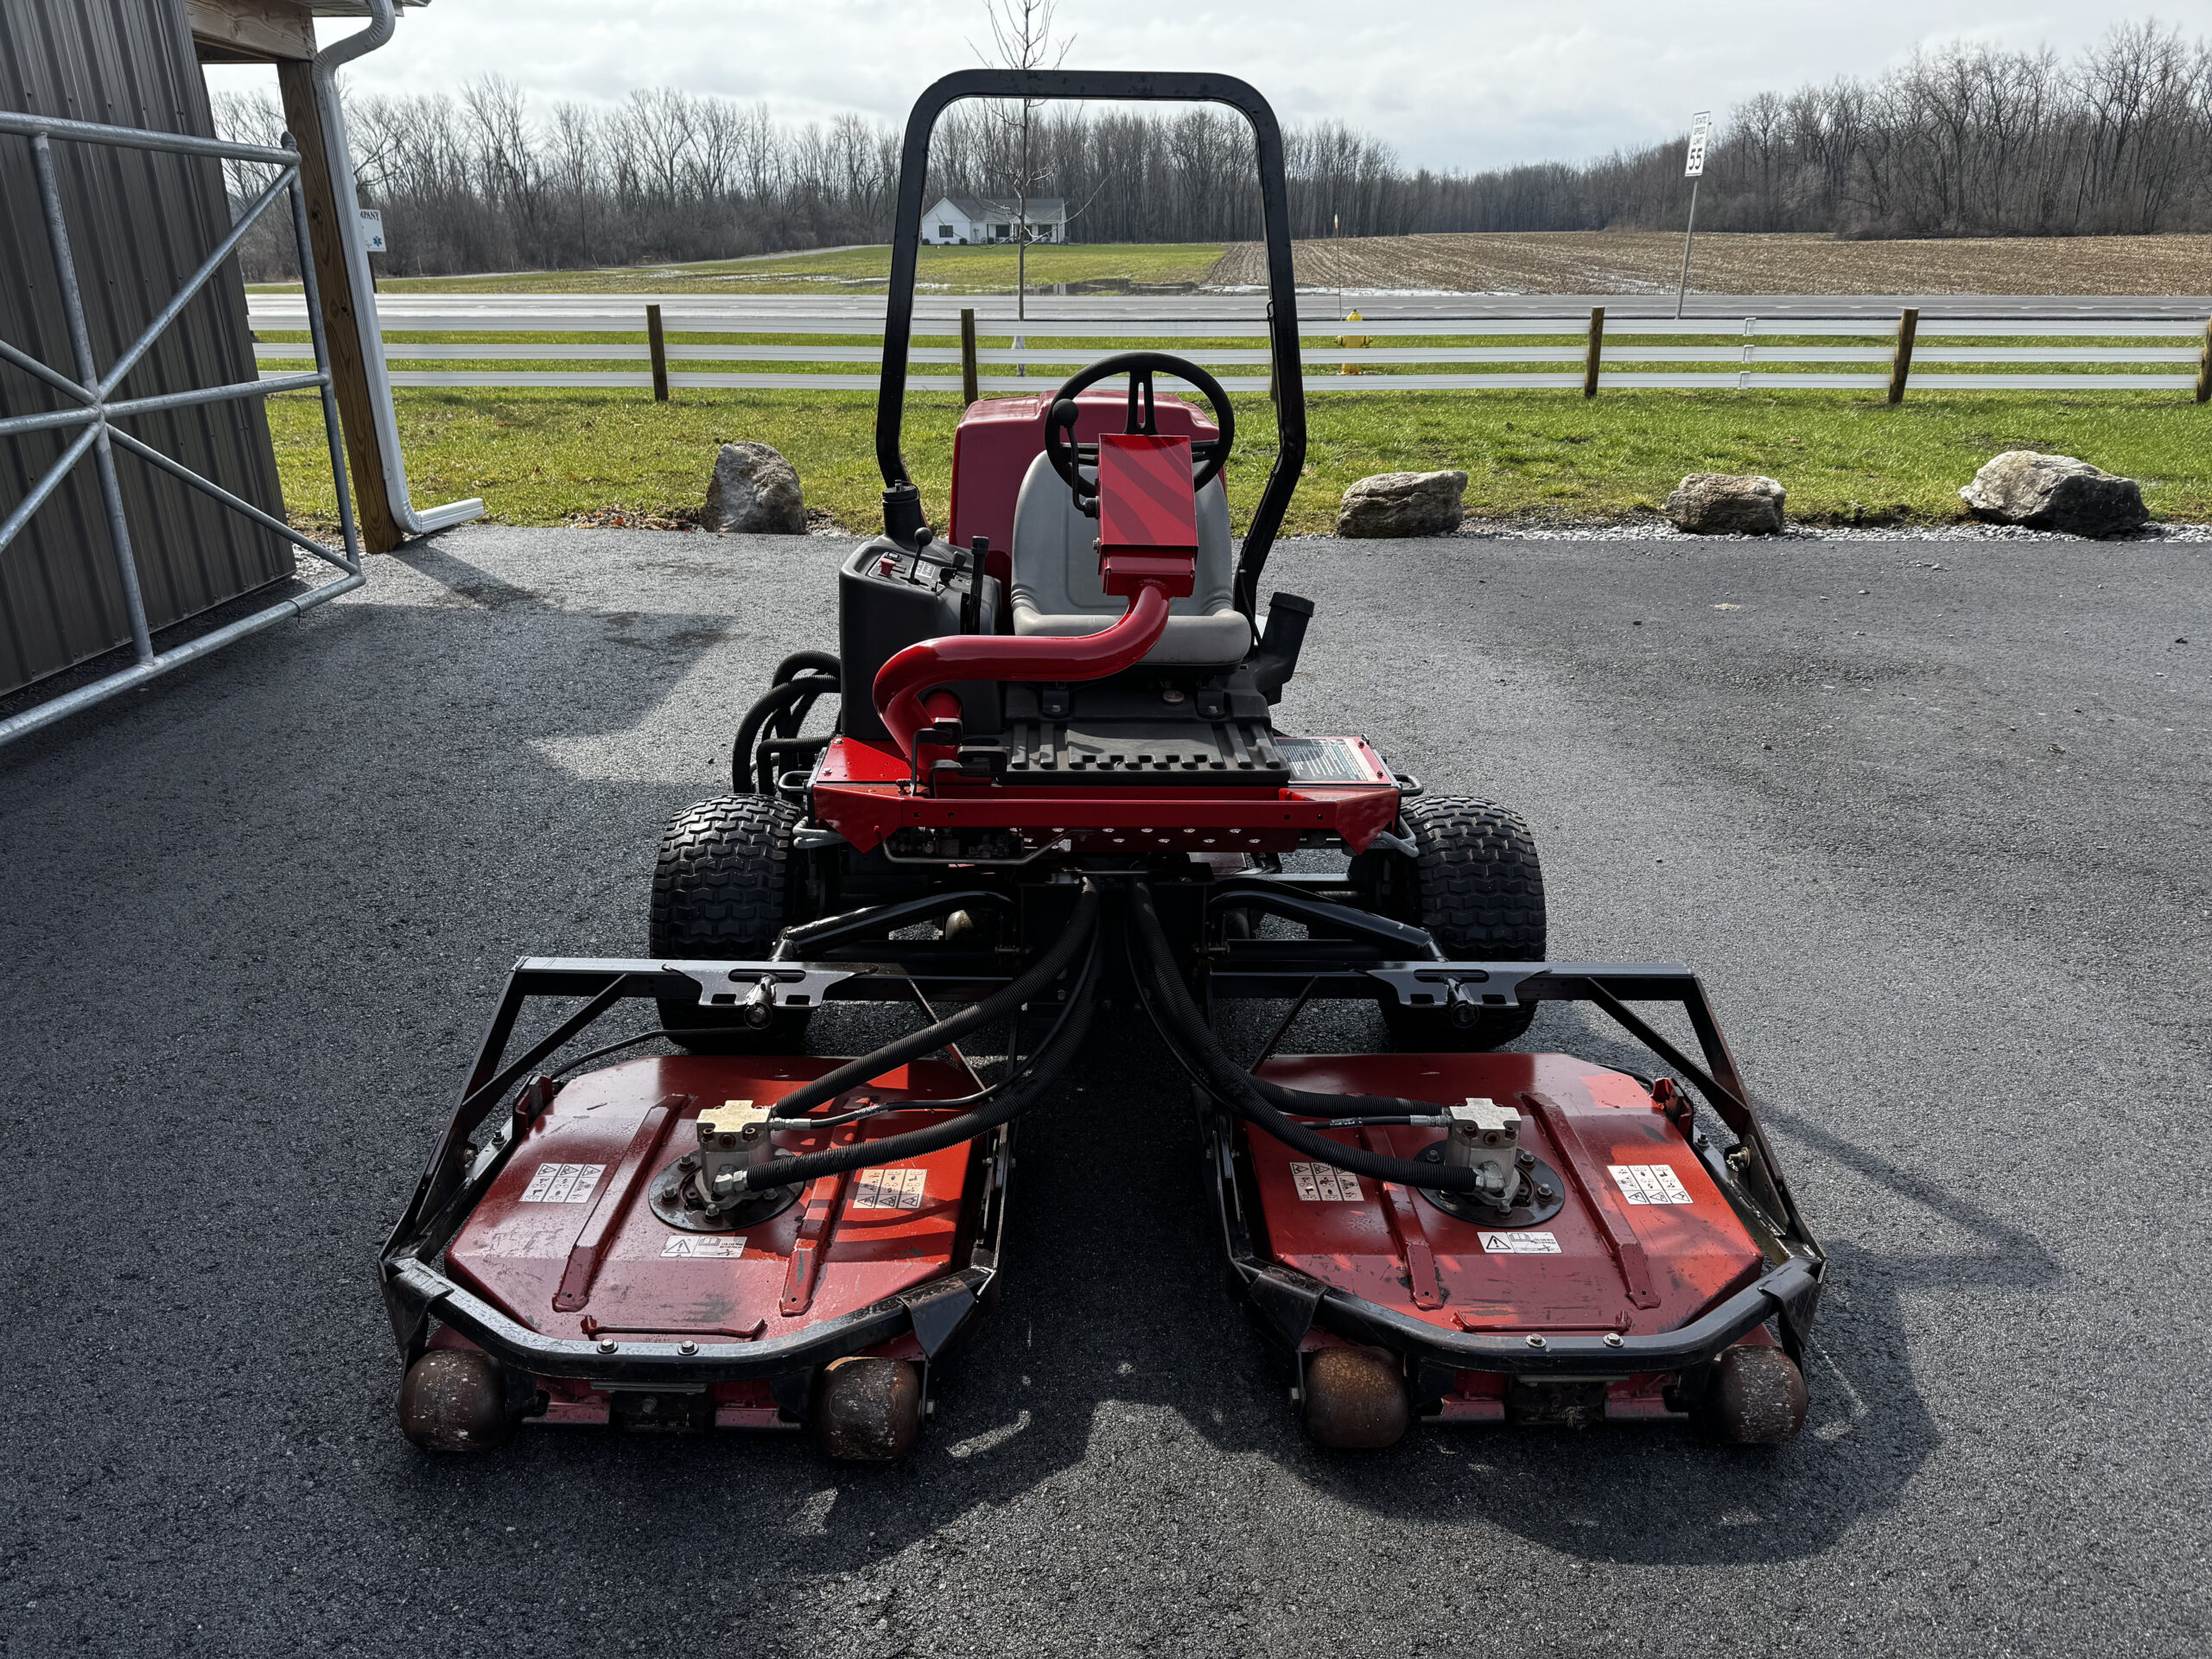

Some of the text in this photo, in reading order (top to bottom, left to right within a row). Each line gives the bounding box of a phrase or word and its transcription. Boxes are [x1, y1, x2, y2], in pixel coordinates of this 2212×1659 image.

[1695, 116, 1707, 124] STATE
[1694, 127, 1705, 135] SPEED
[1689, 148, 1703, 170] 55
